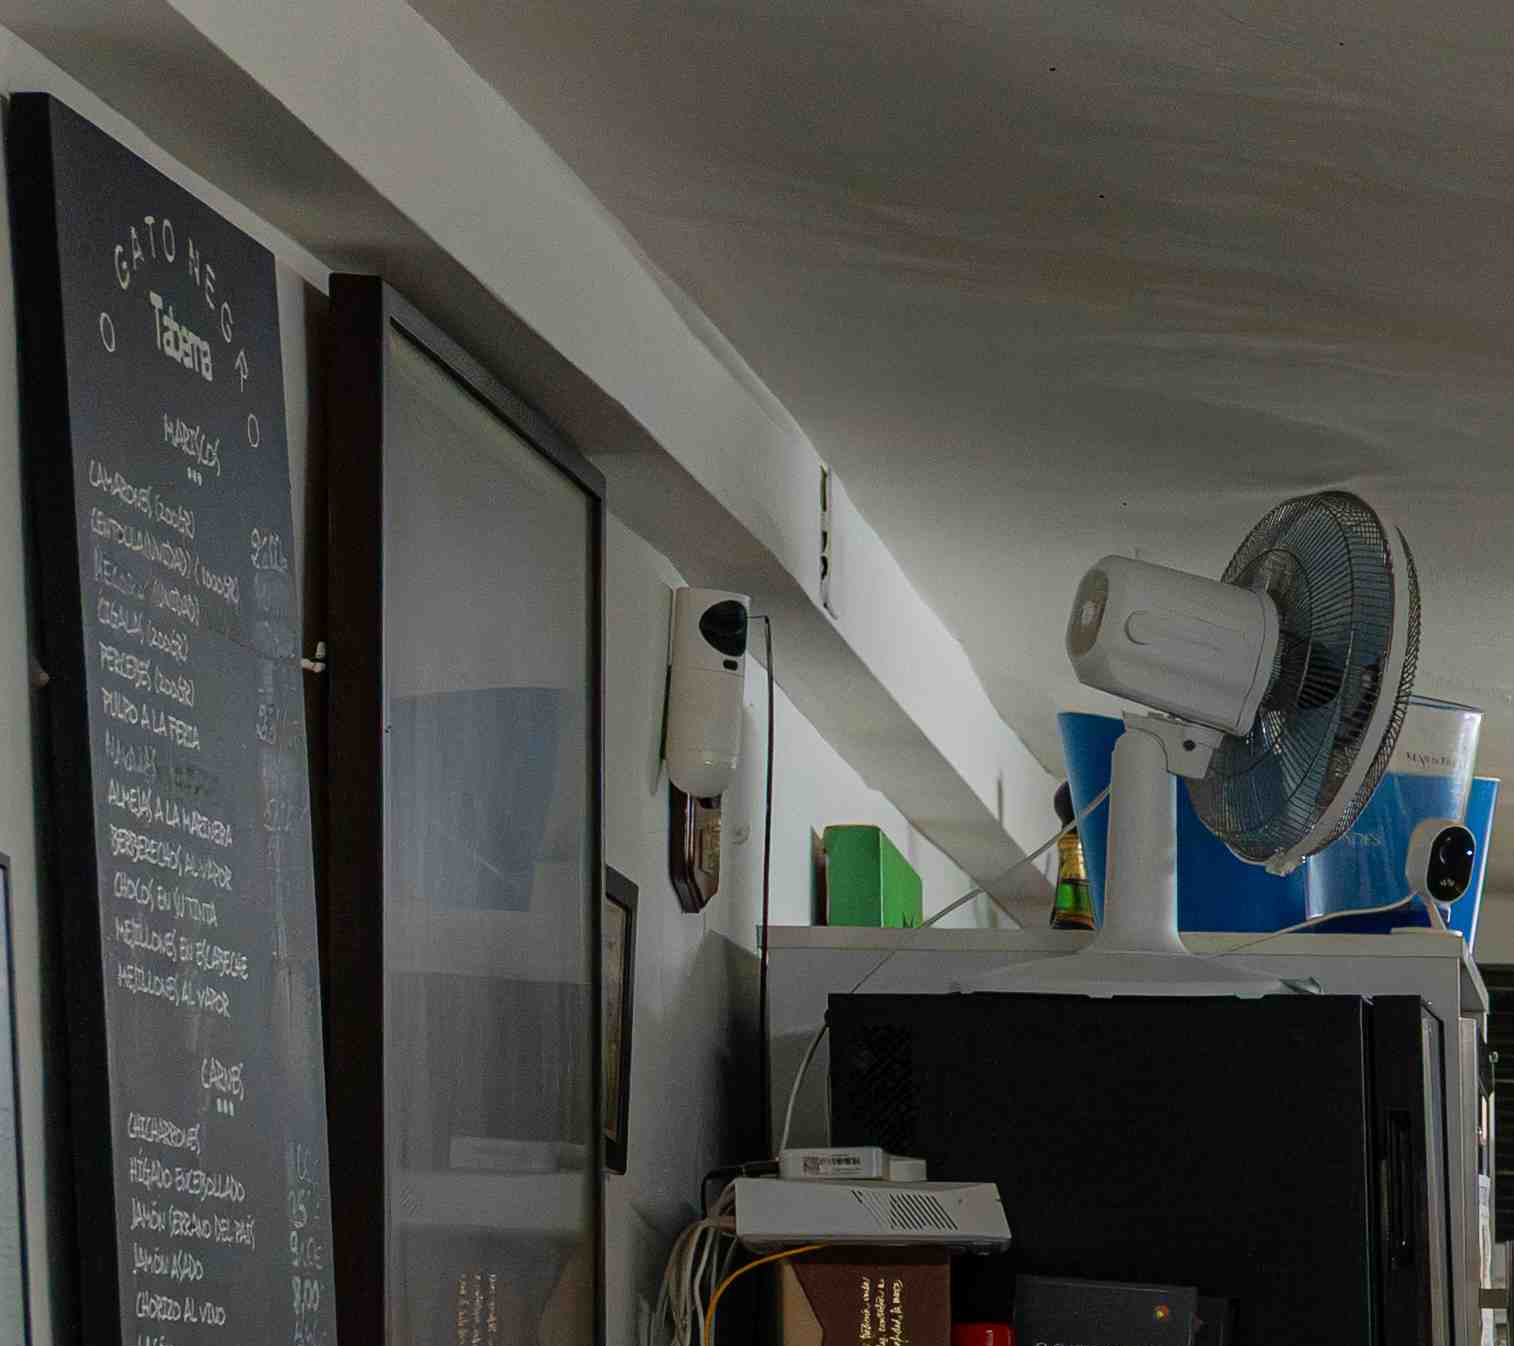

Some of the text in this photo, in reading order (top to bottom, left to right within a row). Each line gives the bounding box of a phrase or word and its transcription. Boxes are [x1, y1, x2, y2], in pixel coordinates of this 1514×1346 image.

[113, 215, 176, 291] GATO
[135, 1290, 181, 1322] CHORIZO
[183, 1297, 198, 1322] AL
